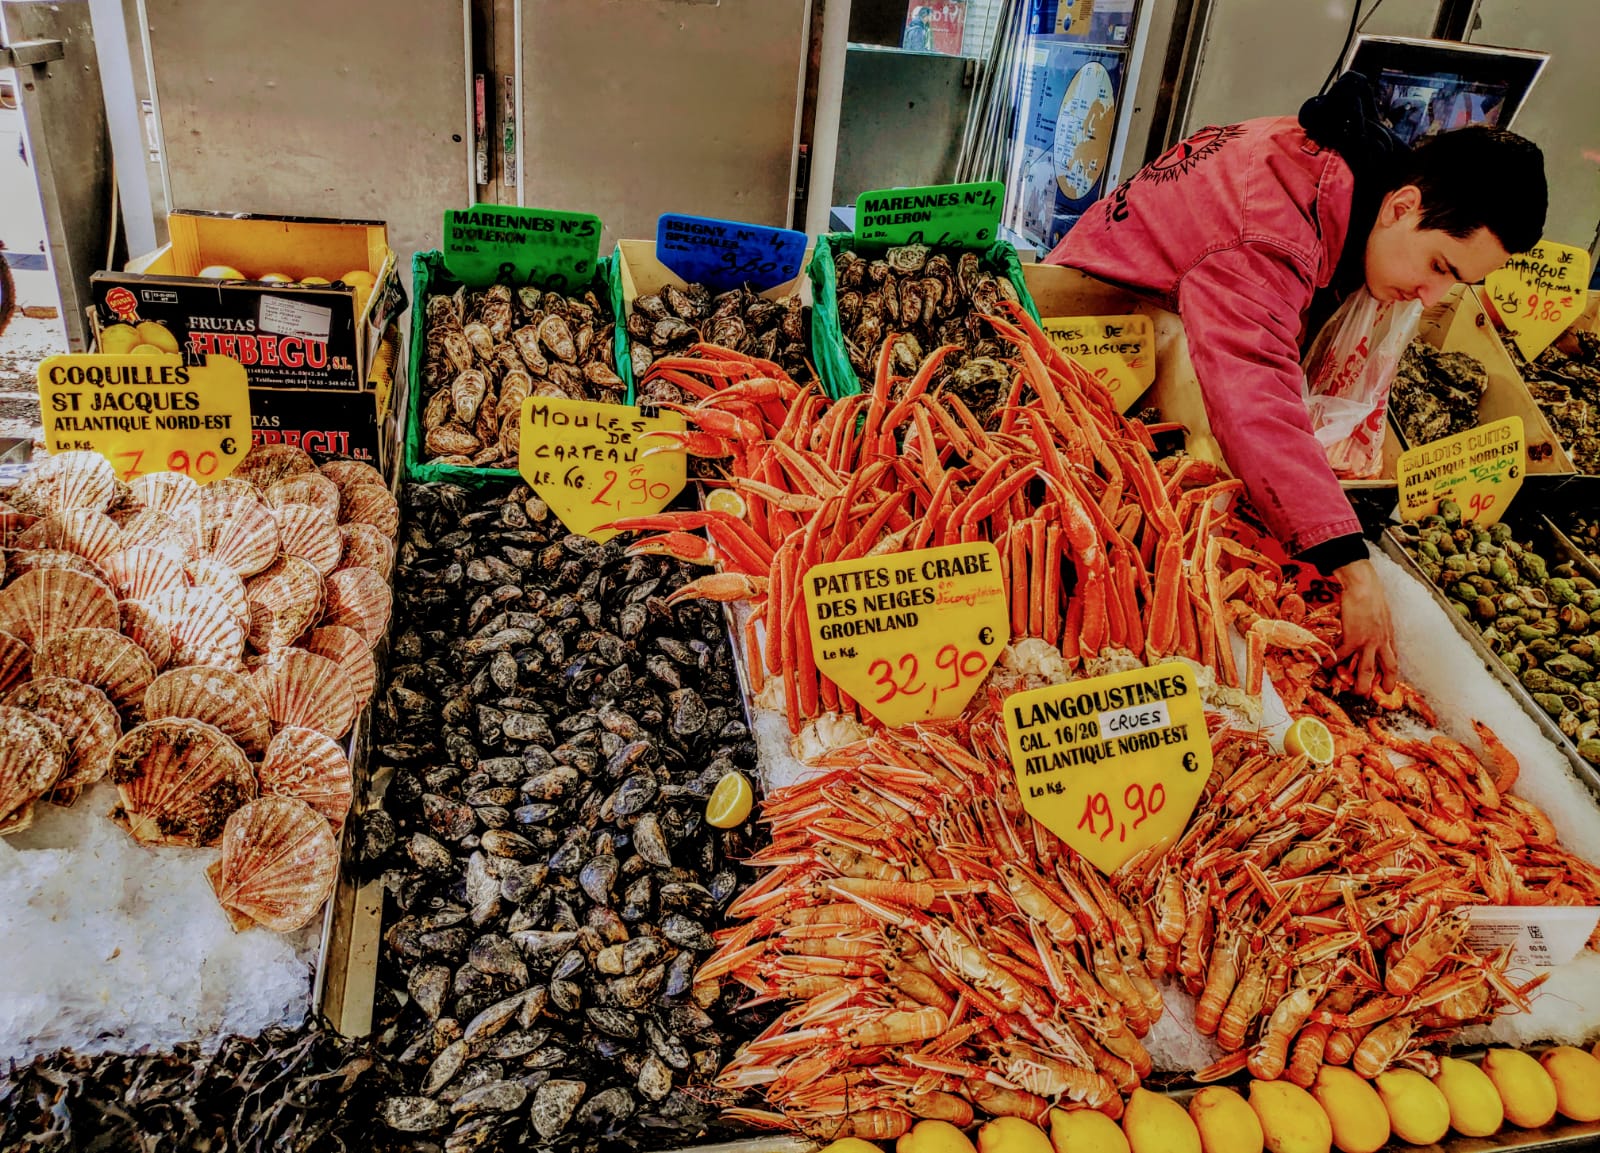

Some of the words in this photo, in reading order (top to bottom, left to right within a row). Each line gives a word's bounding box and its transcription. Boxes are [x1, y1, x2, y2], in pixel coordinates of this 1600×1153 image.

[864, 192, 960, 213] MARENNES
[982, 189, 997, 211] 4
[453, 211, 555, 232] MARENNES
[575, 220, 597, 237] 5
[666, 220, 727, 237] ISIGNY
[863, 211, 932, 227] D'OLERON
[452, 227, 526, 244] D'OLERON
[665, 232, 739, 250] SPECIALES
[976, 228, 989, 240] €
[574, 260, 588, 274] €
[1498, 258, 1567, 281] AMARGUE
[1521, 294, 1562, 322] 9,80
[188, 316, 256, 332] FRUTAS
[1102, 325, 1124, 340] DE
[1061, 343, 1142, 356] OUZIGUES
[49, 366, 190, 388] COQUILLES
[52, 392, 83, 412] ST
[90, 392, 200, 414] JACQUES
[54, 416, 151, 432] ATLANTIQUE
[156, 415, 233, 430] NORD-EST
[251, 415, 281, 427] TAS
[530, 404, 647, 432] MOULES
[56, 440, 70, 450] Le
[74, 440, 95, 451] Kg.
[220, 437, 237, 455] €
[605, 432, 632, 445] DE
[534, 445, 639, 464] CARTEAU
[1403, 442, 1462, 473] BULOTS
[1467, 426, 1511, 451] CUITS
[1405, 458, 1466, 488] ATLANTIQUE
[1469, 440, 1520, 465] NORD-EST
[1508, 465, 1520, 479] €
[591, 470, 671, 512] 2,90
[813, 567, 891, 597] PATTES
[895, 568, 918, 585] DE
[921, 553, 993, 580] CRABE
[817, 598, 857, 620] DES
[863, 587, 936, 613] NEIGES
[820, 612, 919, 640] GROENLAND
[978, 626, 995, 646] €
[822, 650, 837, 660] Le
[839, 646, 859, 659] Kg.
[867, 643, 988, 716] 32,90
[1014, 674, 1188, 729] LANGOUSTINES
[1019, 731, 1051, 752] CAL.
[1054, 720, 1098, 746] 16/20
[1109, 710, 1162, 732] CRUES
[1025, 741, 1116, 776] ATLANTIQUE
[1118, 724, 1189, 755] NORD-EST
[1182, 751, 1199, 772] €
[1029, 785, 1045, 798] Le
[1046, 780, 1067, 795] Kg.
[1076, 782, 1166, 843] 19,90
